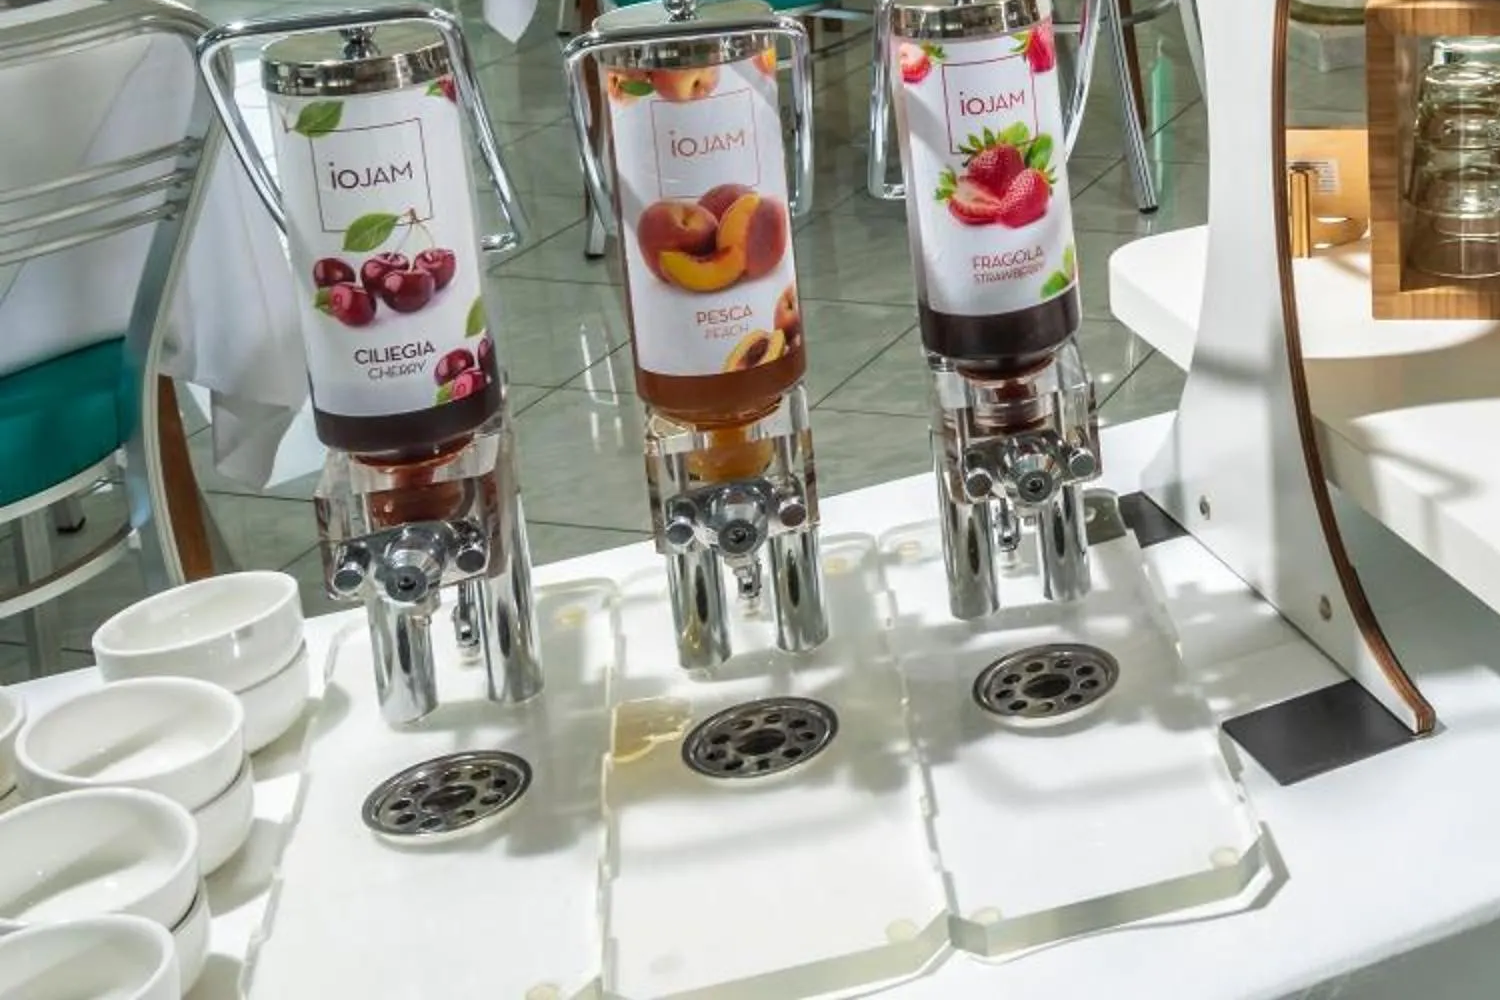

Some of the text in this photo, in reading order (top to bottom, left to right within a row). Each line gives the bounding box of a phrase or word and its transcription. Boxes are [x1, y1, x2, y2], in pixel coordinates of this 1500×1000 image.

[972, 245, 1044, 269] FRAGOLA
[696, 304, 753, 326] PESCA
[354, 340, 436, 365] CILIEGIA
[367, 360, 427, 380] CHERRY
